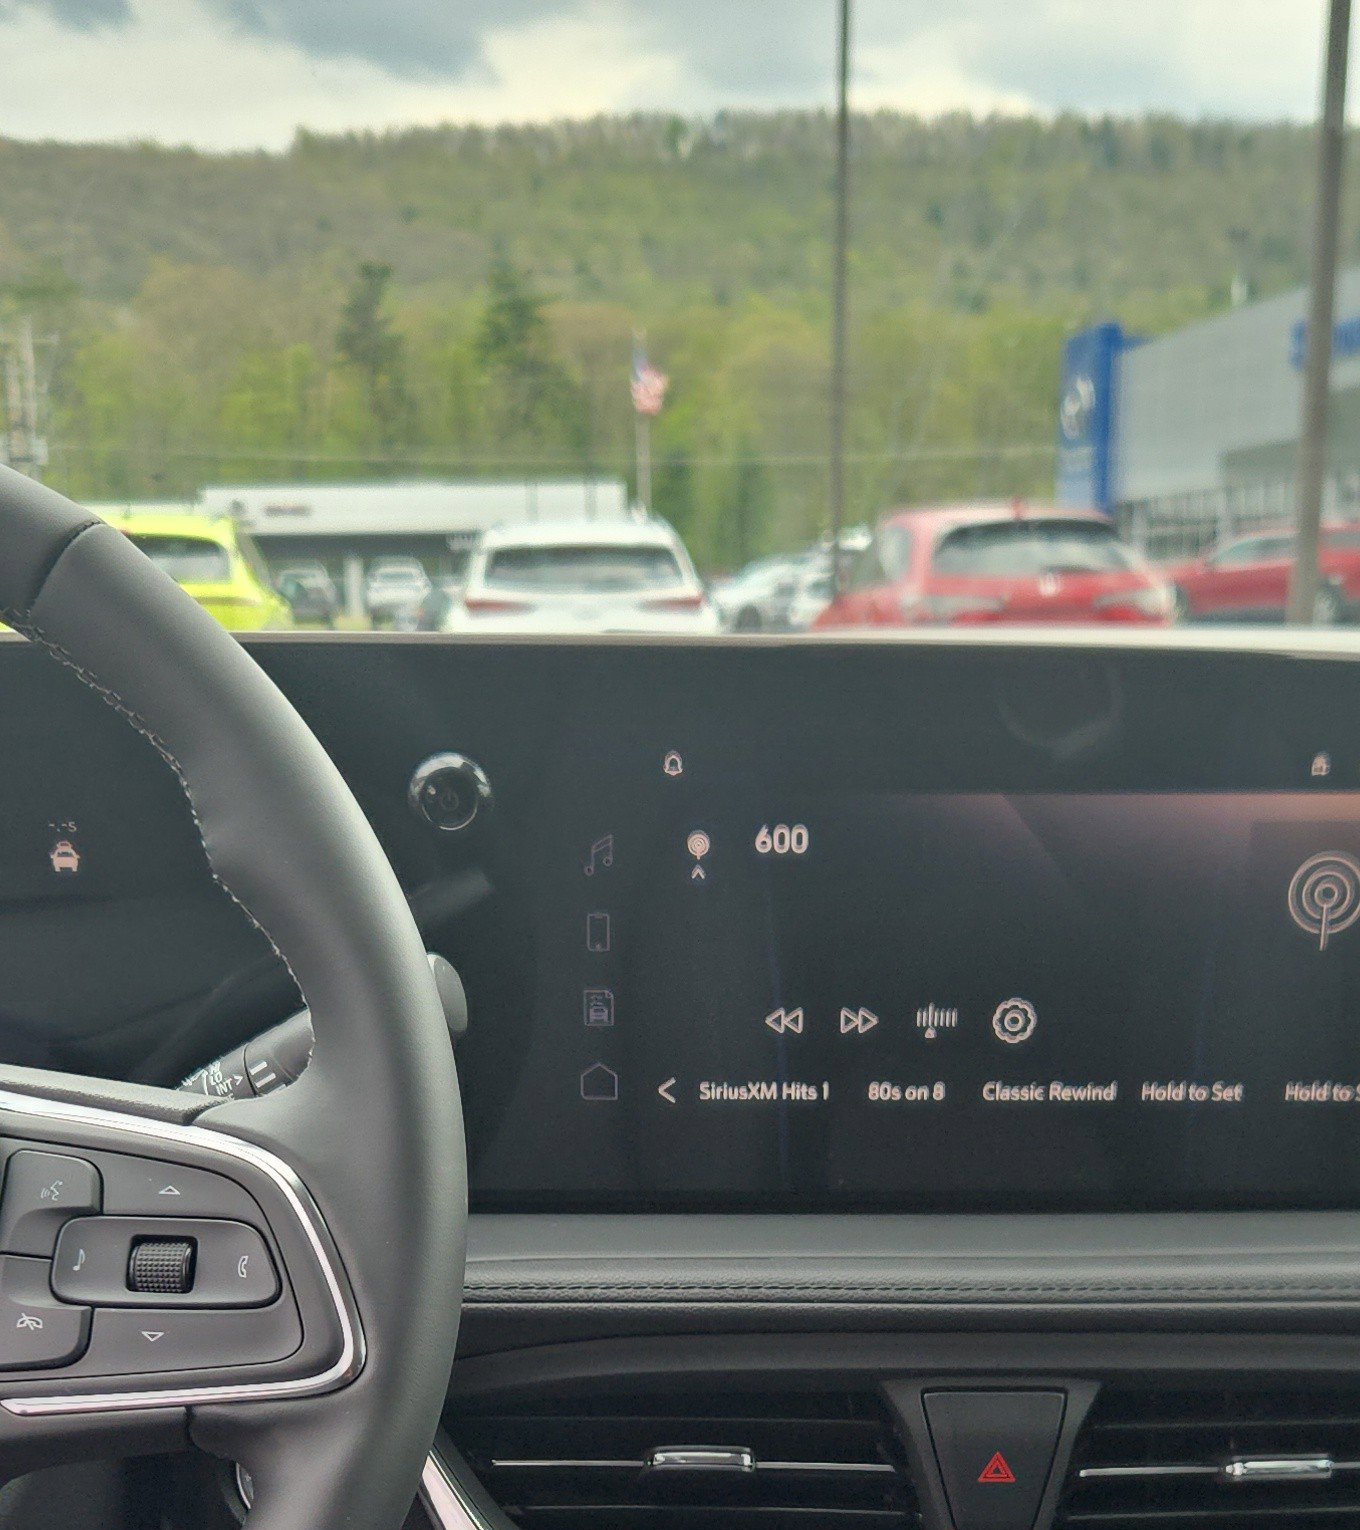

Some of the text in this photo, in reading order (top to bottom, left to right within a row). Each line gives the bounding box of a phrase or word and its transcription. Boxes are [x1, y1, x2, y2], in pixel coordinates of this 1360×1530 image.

[755, 823, 809, 853] 600
[215, 1078, 232, 1095] INT
[699, 1080, 830, 1100] SiriusXM Hits 1
[868, 1081, 946, 1101] 80s on 8
[982, 1080, 1118, 1101] Classic Rewind
[1141, 1080, 1244, 1101] Hold to Set
[1285, 1080, 1332, 1101] Hold
[1332, 1083, 1355, 1101] to
